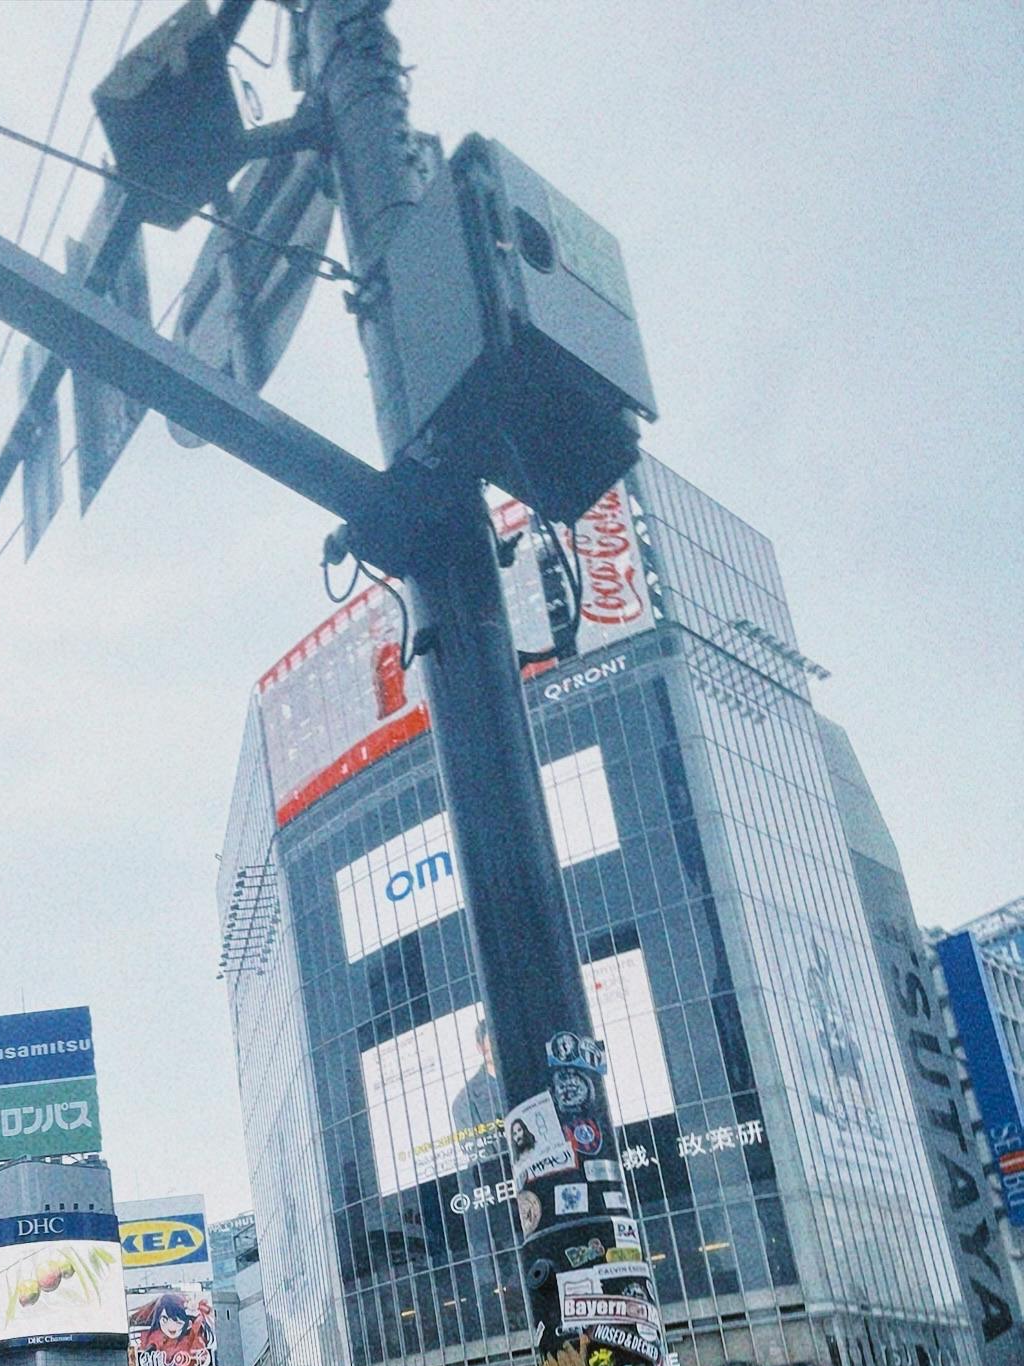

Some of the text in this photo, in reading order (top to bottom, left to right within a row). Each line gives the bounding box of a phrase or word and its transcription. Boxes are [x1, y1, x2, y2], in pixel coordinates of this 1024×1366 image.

[544, 655, 627, 702] QFRONT
[17, 1216, 65, 1237] DHC
[122, 1229, 197, 1254] KEA
[564, 1299, 627, 1319] Bayern
